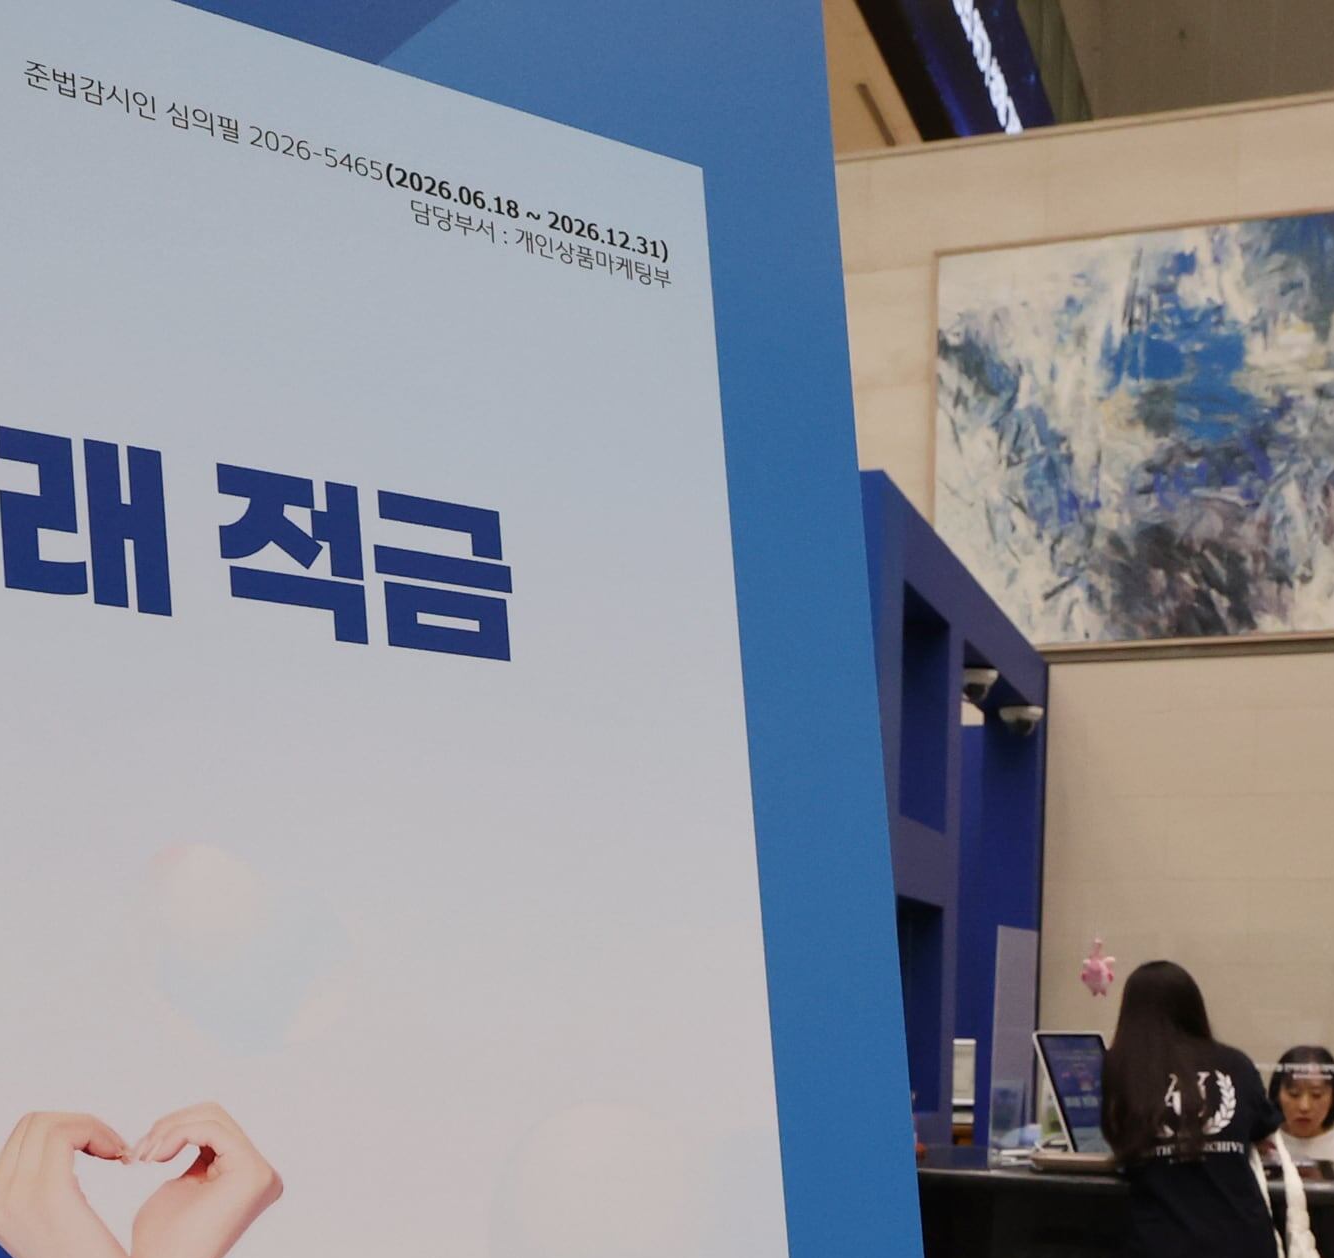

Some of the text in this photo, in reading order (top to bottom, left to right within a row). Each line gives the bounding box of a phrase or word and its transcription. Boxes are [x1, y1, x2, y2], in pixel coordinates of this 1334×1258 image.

[24, 61, 156, 120] 준법감시인
[166, 102, 239, 144] 심의필
[548, 211, 668, 263] 2026.12.31)
[411, 200, 494, 243] 담당부서
[515, 229, 671, 288] 개인상품마케팅부
[216, 462, 513, 662] 적금
